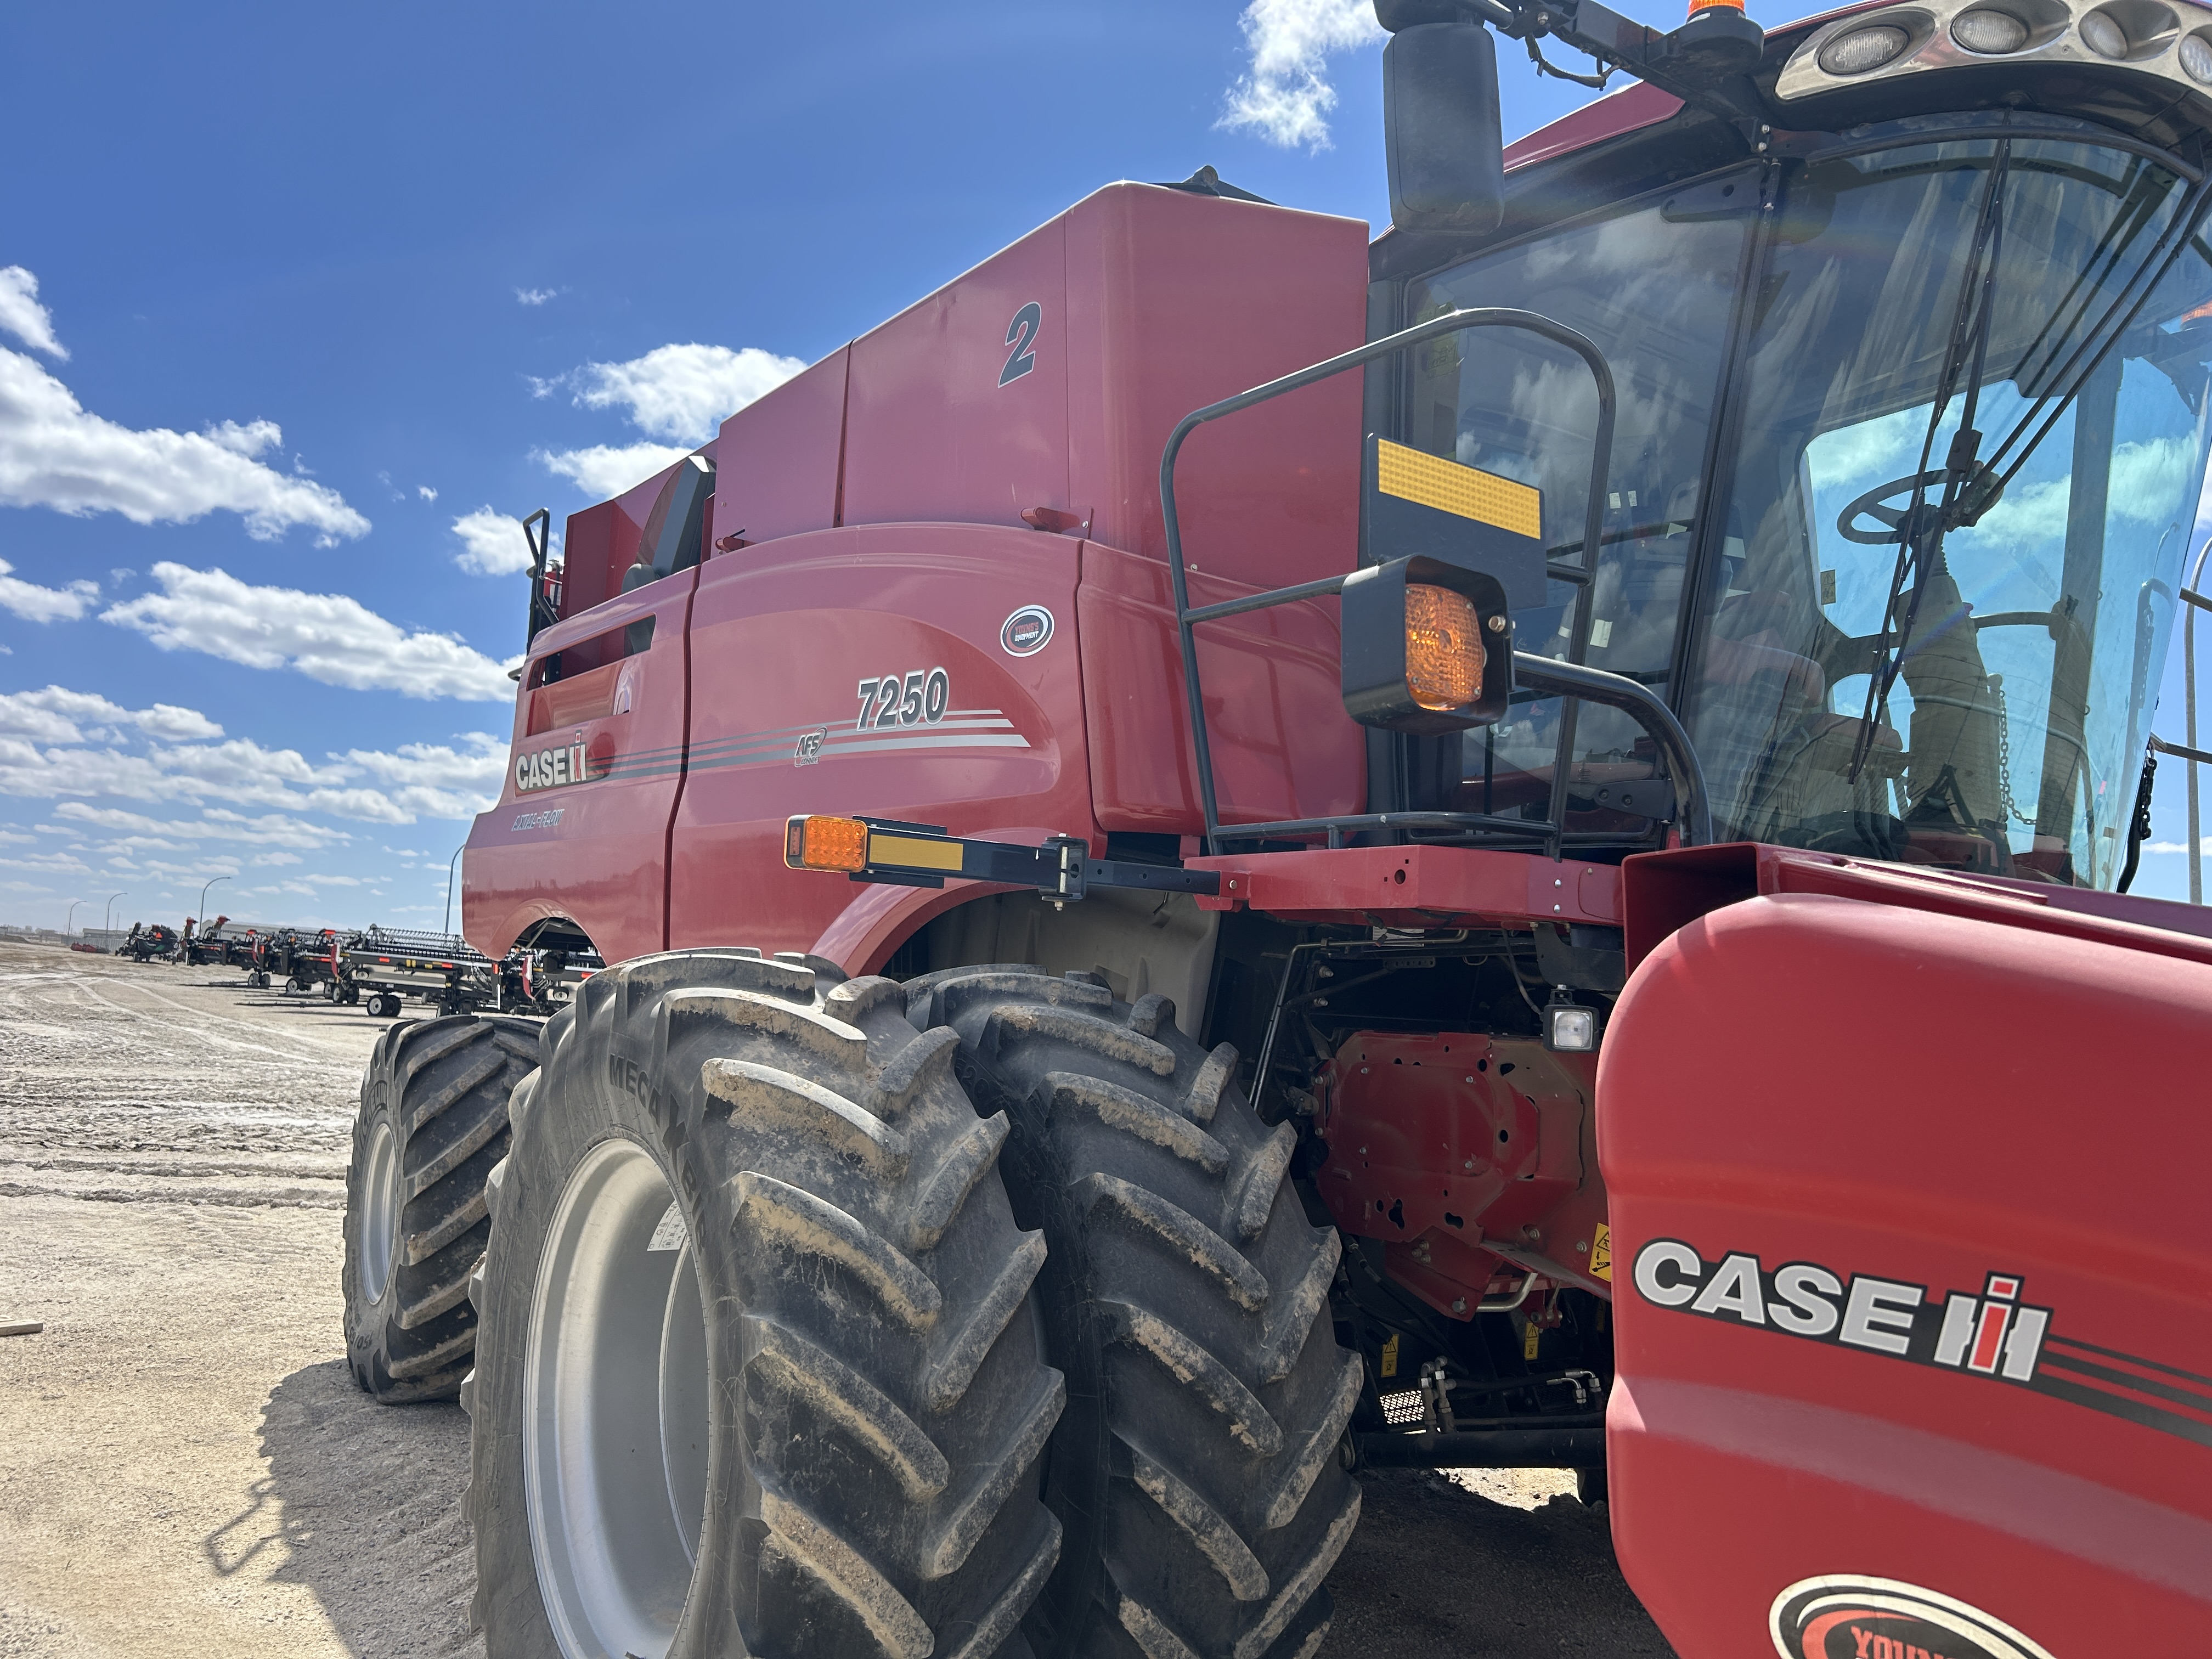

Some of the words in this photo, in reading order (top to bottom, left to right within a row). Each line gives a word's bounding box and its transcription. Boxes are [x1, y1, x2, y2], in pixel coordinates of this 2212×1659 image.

[997, 301, 1042, 388] 2
[856, 666, 949, 731] 7250
[516, 749, 567, 790] CASE
[794, 732, 821, 758] AFS
[1634, 1241, 1923, 1355] CASE
